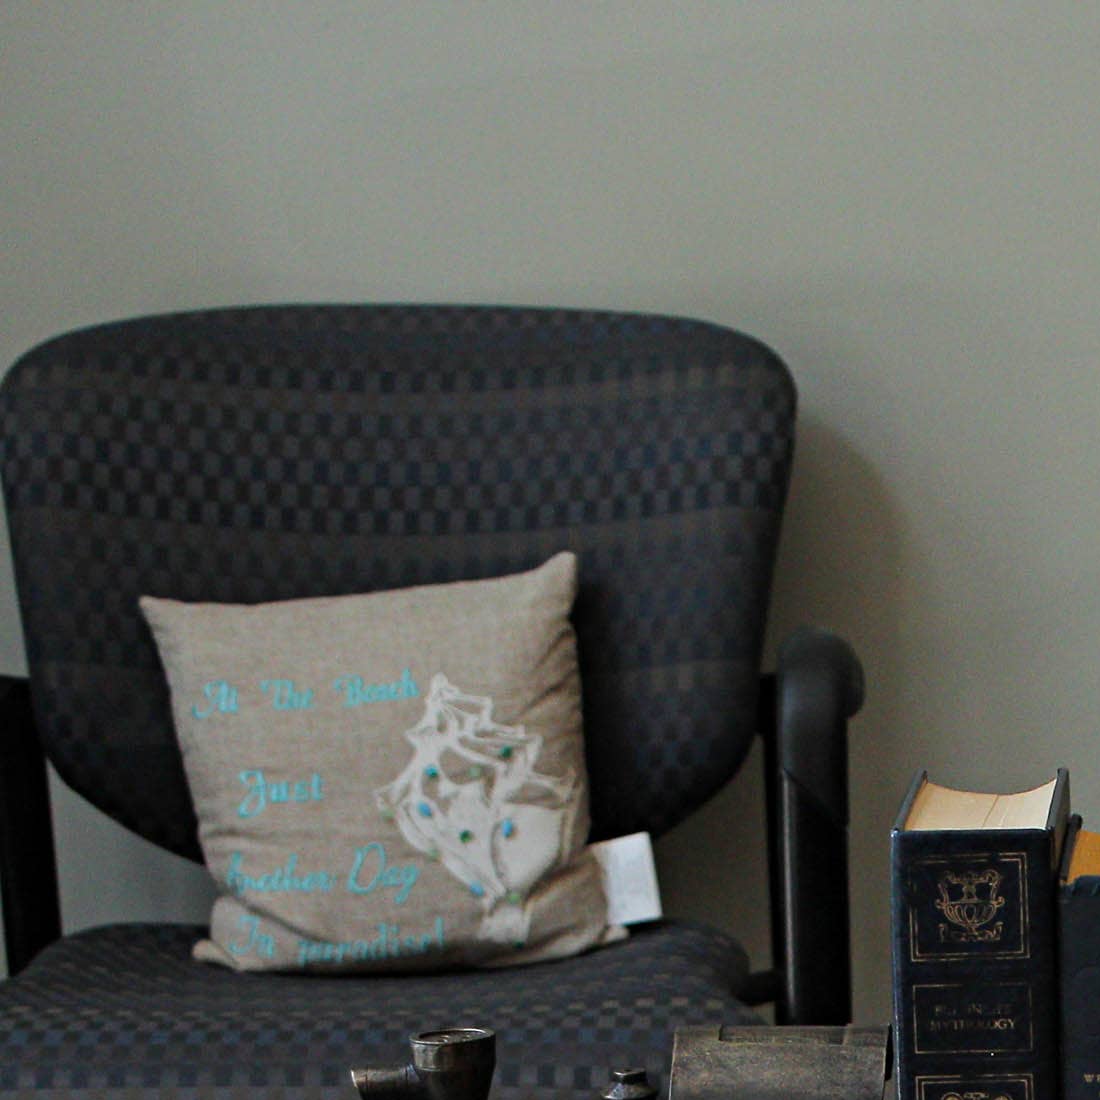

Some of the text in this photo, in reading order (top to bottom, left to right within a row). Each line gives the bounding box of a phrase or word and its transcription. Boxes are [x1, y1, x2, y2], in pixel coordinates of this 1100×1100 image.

[260, 679, 315, 711] The
[333, 667, 419, 708] Beach
[237, 769, 325, 819] Just
[227, 842, 420, 904] Another Day
[229, 914, 276, 960] In
